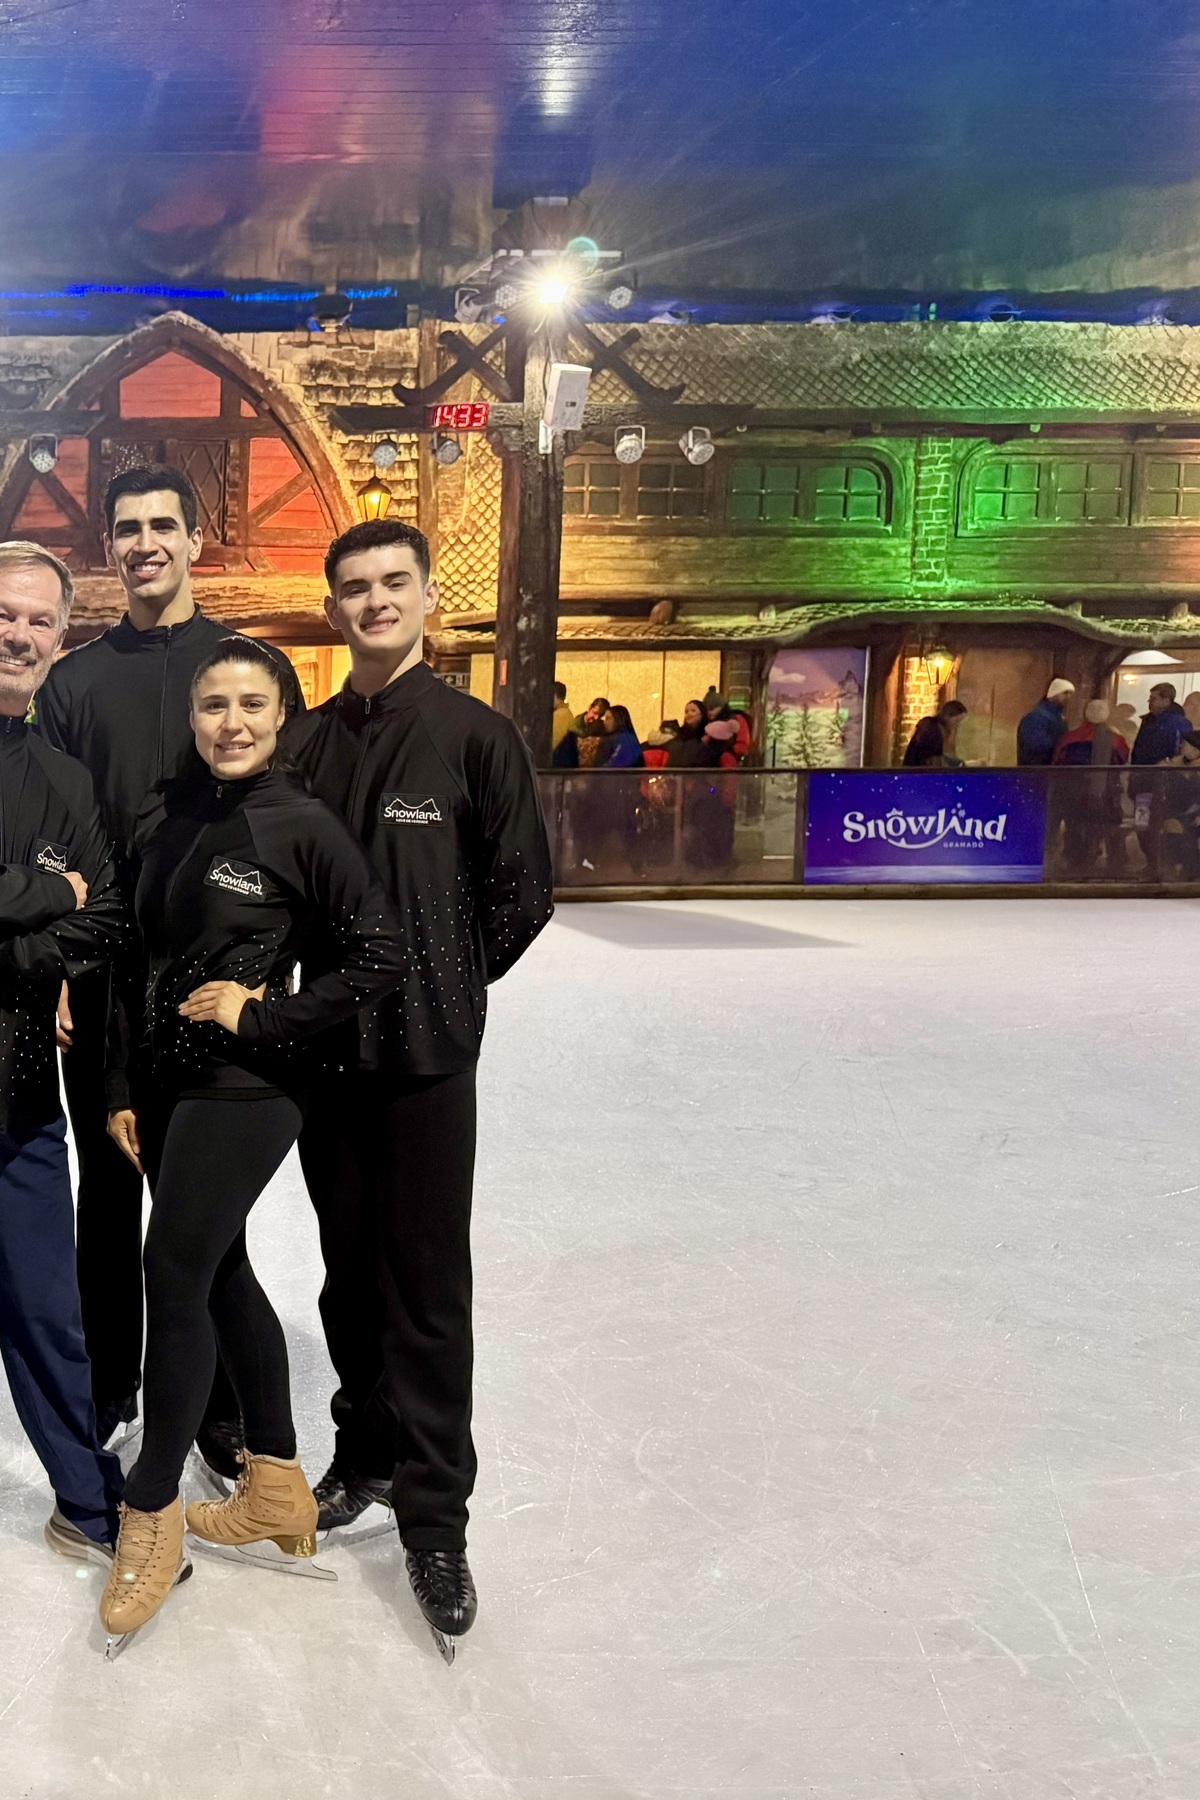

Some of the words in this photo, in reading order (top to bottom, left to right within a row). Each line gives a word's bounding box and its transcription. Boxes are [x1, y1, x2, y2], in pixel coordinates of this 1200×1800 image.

[383, 806, 443, 821] Snowland
[842, 807, 1008, 849] Snowland
[209, 869, 263, 896] Snowland
